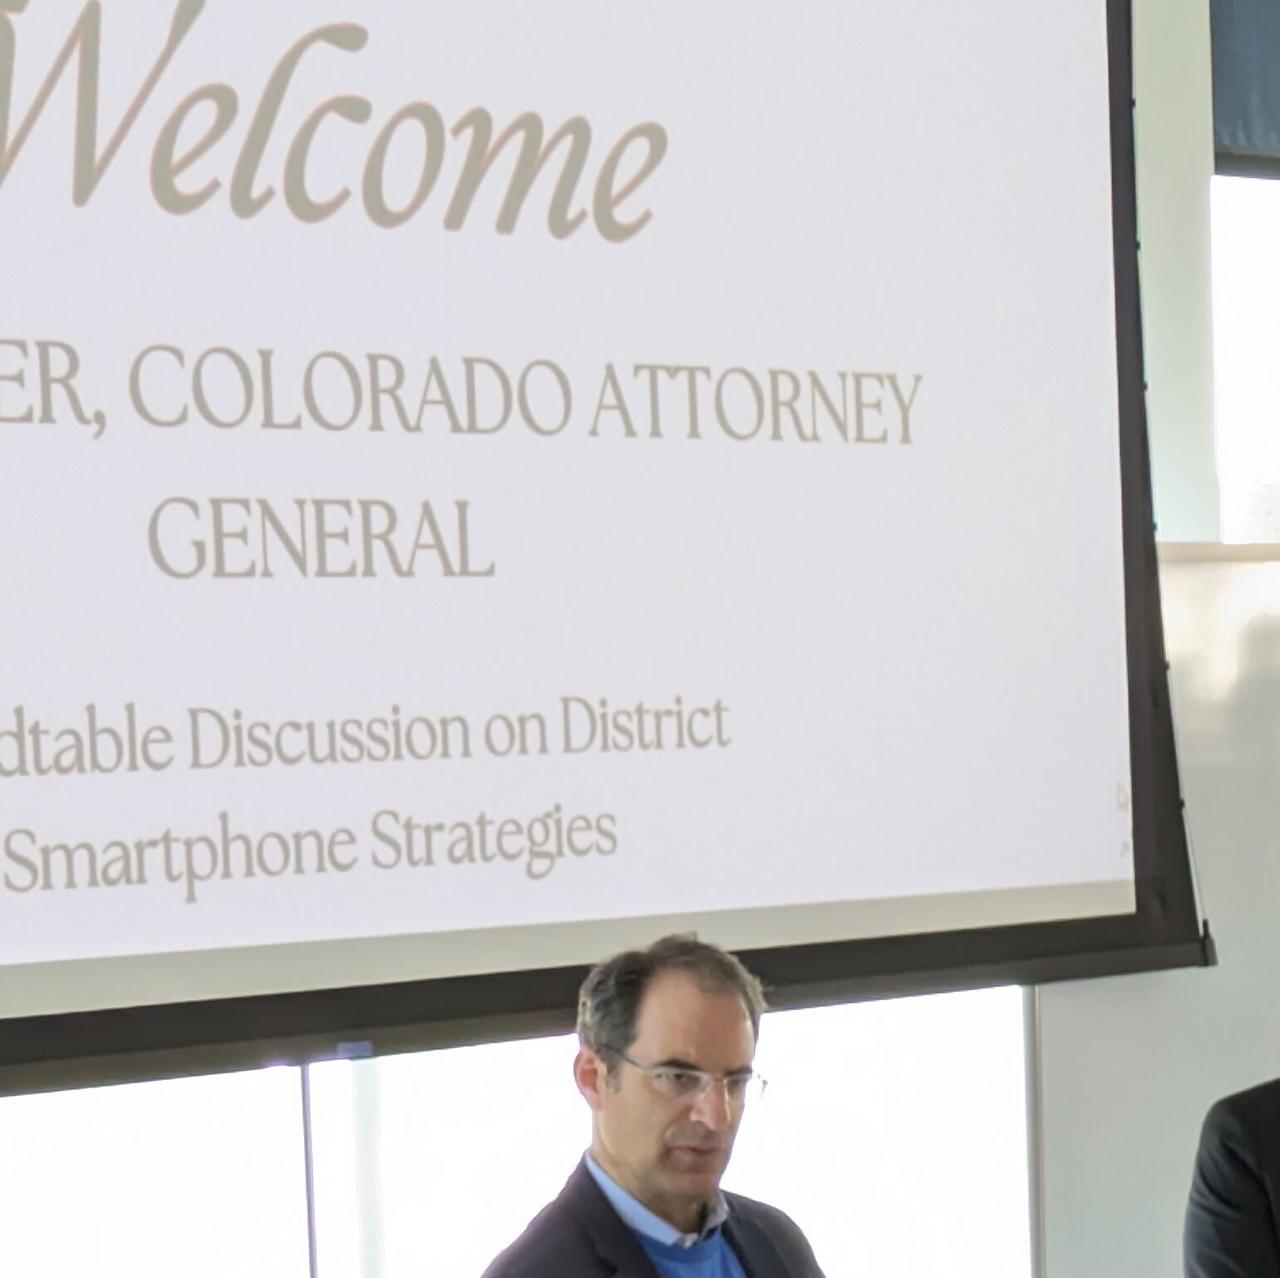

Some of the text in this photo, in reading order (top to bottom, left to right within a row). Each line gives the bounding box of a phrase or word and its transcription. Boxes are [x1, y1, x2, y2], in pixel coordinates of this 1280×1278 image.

[0, 0, 668, 244] Welcome
[128, 344, 573, 437] COLORADO
[588, 362, 923, 445] ATTORNEY
[147, 496, 496, 579] GENERAL
[187, 704, 472, 769] Discussion
[484, 712, 549, 757] on
[560, 695, 732, 754] District
[3, 803, 618, 904] Smartphone Strategies
